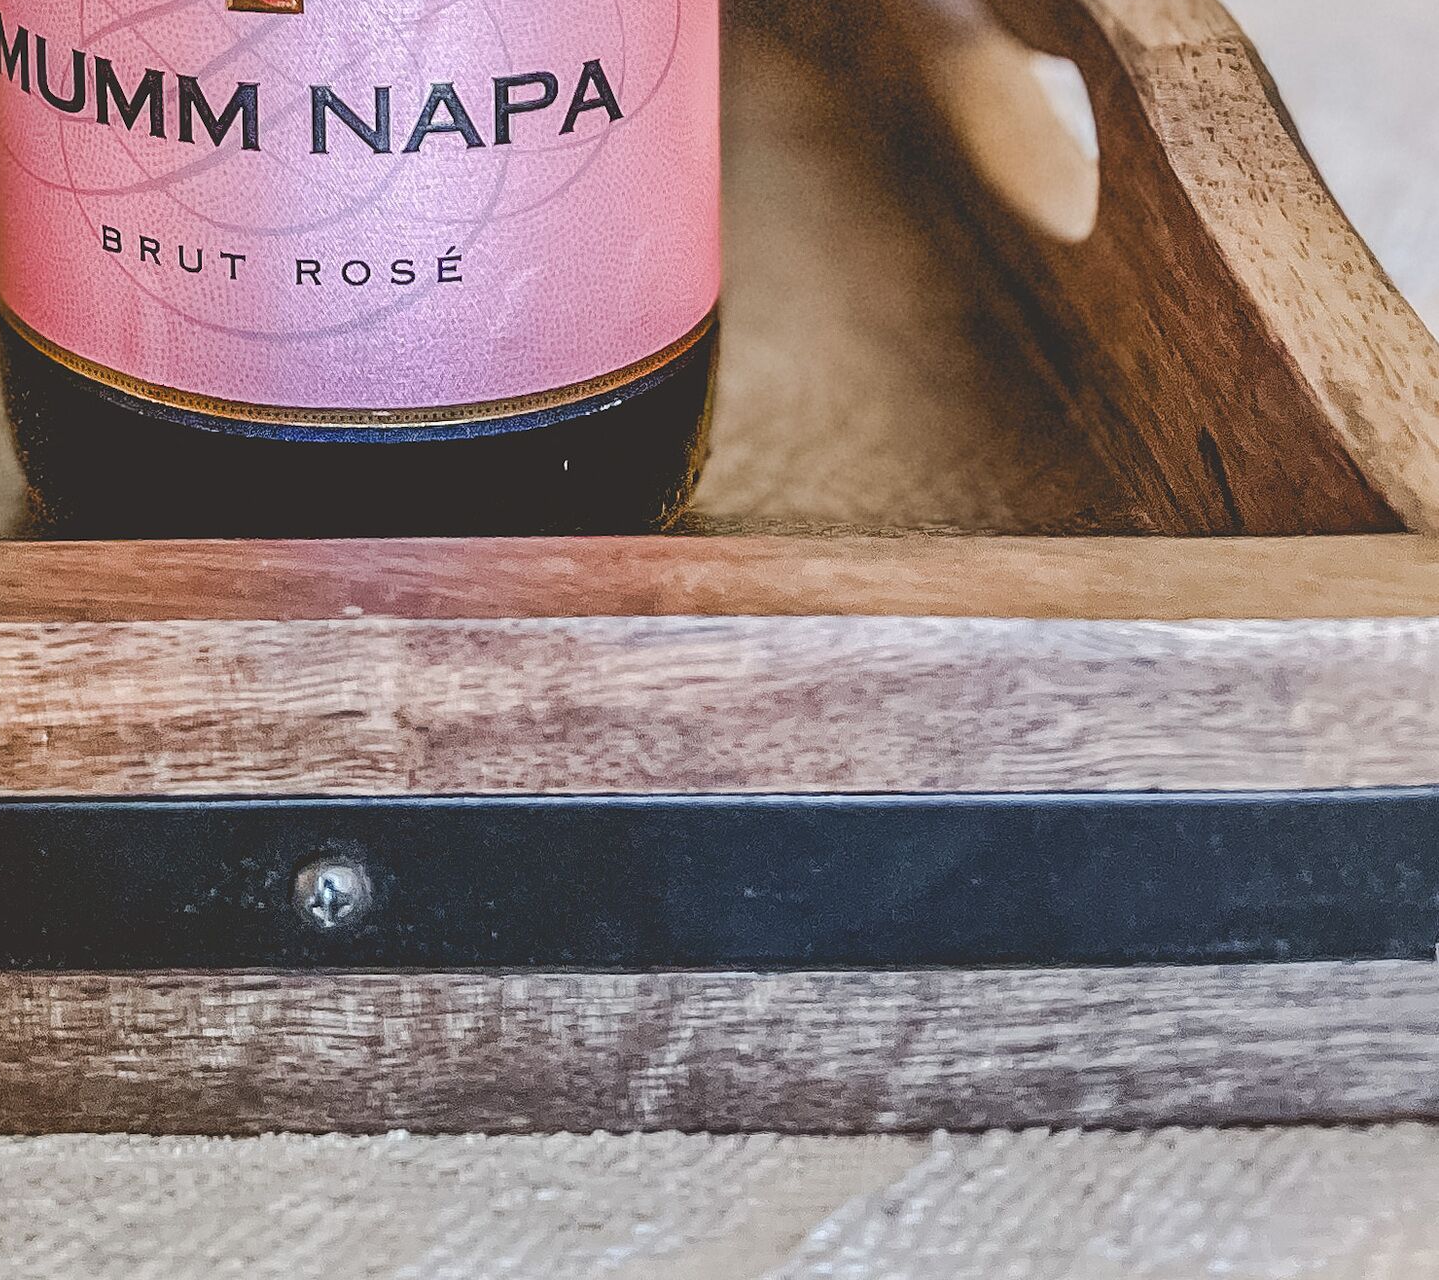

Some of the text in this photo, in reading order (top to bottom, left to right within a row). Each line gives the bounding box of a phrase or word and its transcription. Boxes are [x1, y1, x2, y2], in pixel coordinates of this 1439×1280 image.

[309, 57, 624, 155] NAPA
[101, 224, 464, 286] BRUT ROSÉ
